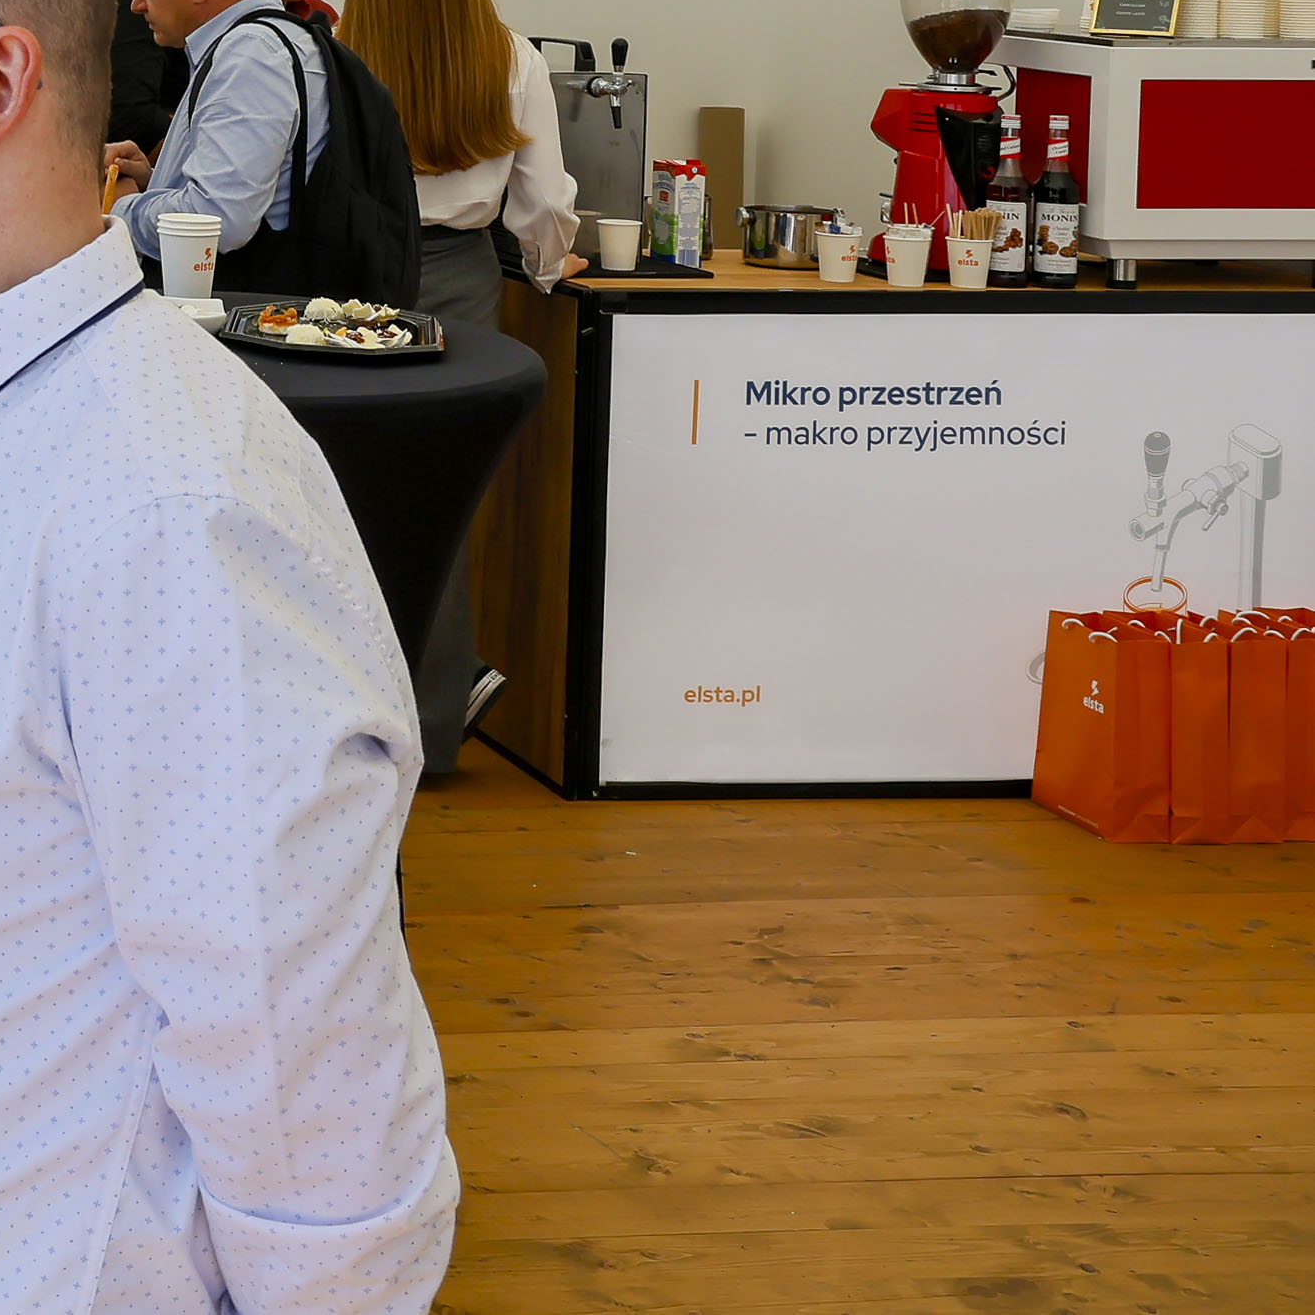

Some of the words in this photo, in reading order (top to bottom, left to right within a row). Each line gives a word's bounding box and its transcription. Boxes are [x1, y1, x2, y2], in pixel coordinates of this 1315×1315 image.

[745, 380, 831, 406] Mikro
[838, 380, 1003, 413] przestrzeń
[765, 420, 858, 446] makro
[867, 420, 1067, 452] przyjemności
[683, 685, 761, 707] elsta.pl
[1083, 695, 1105, 714] elsta
